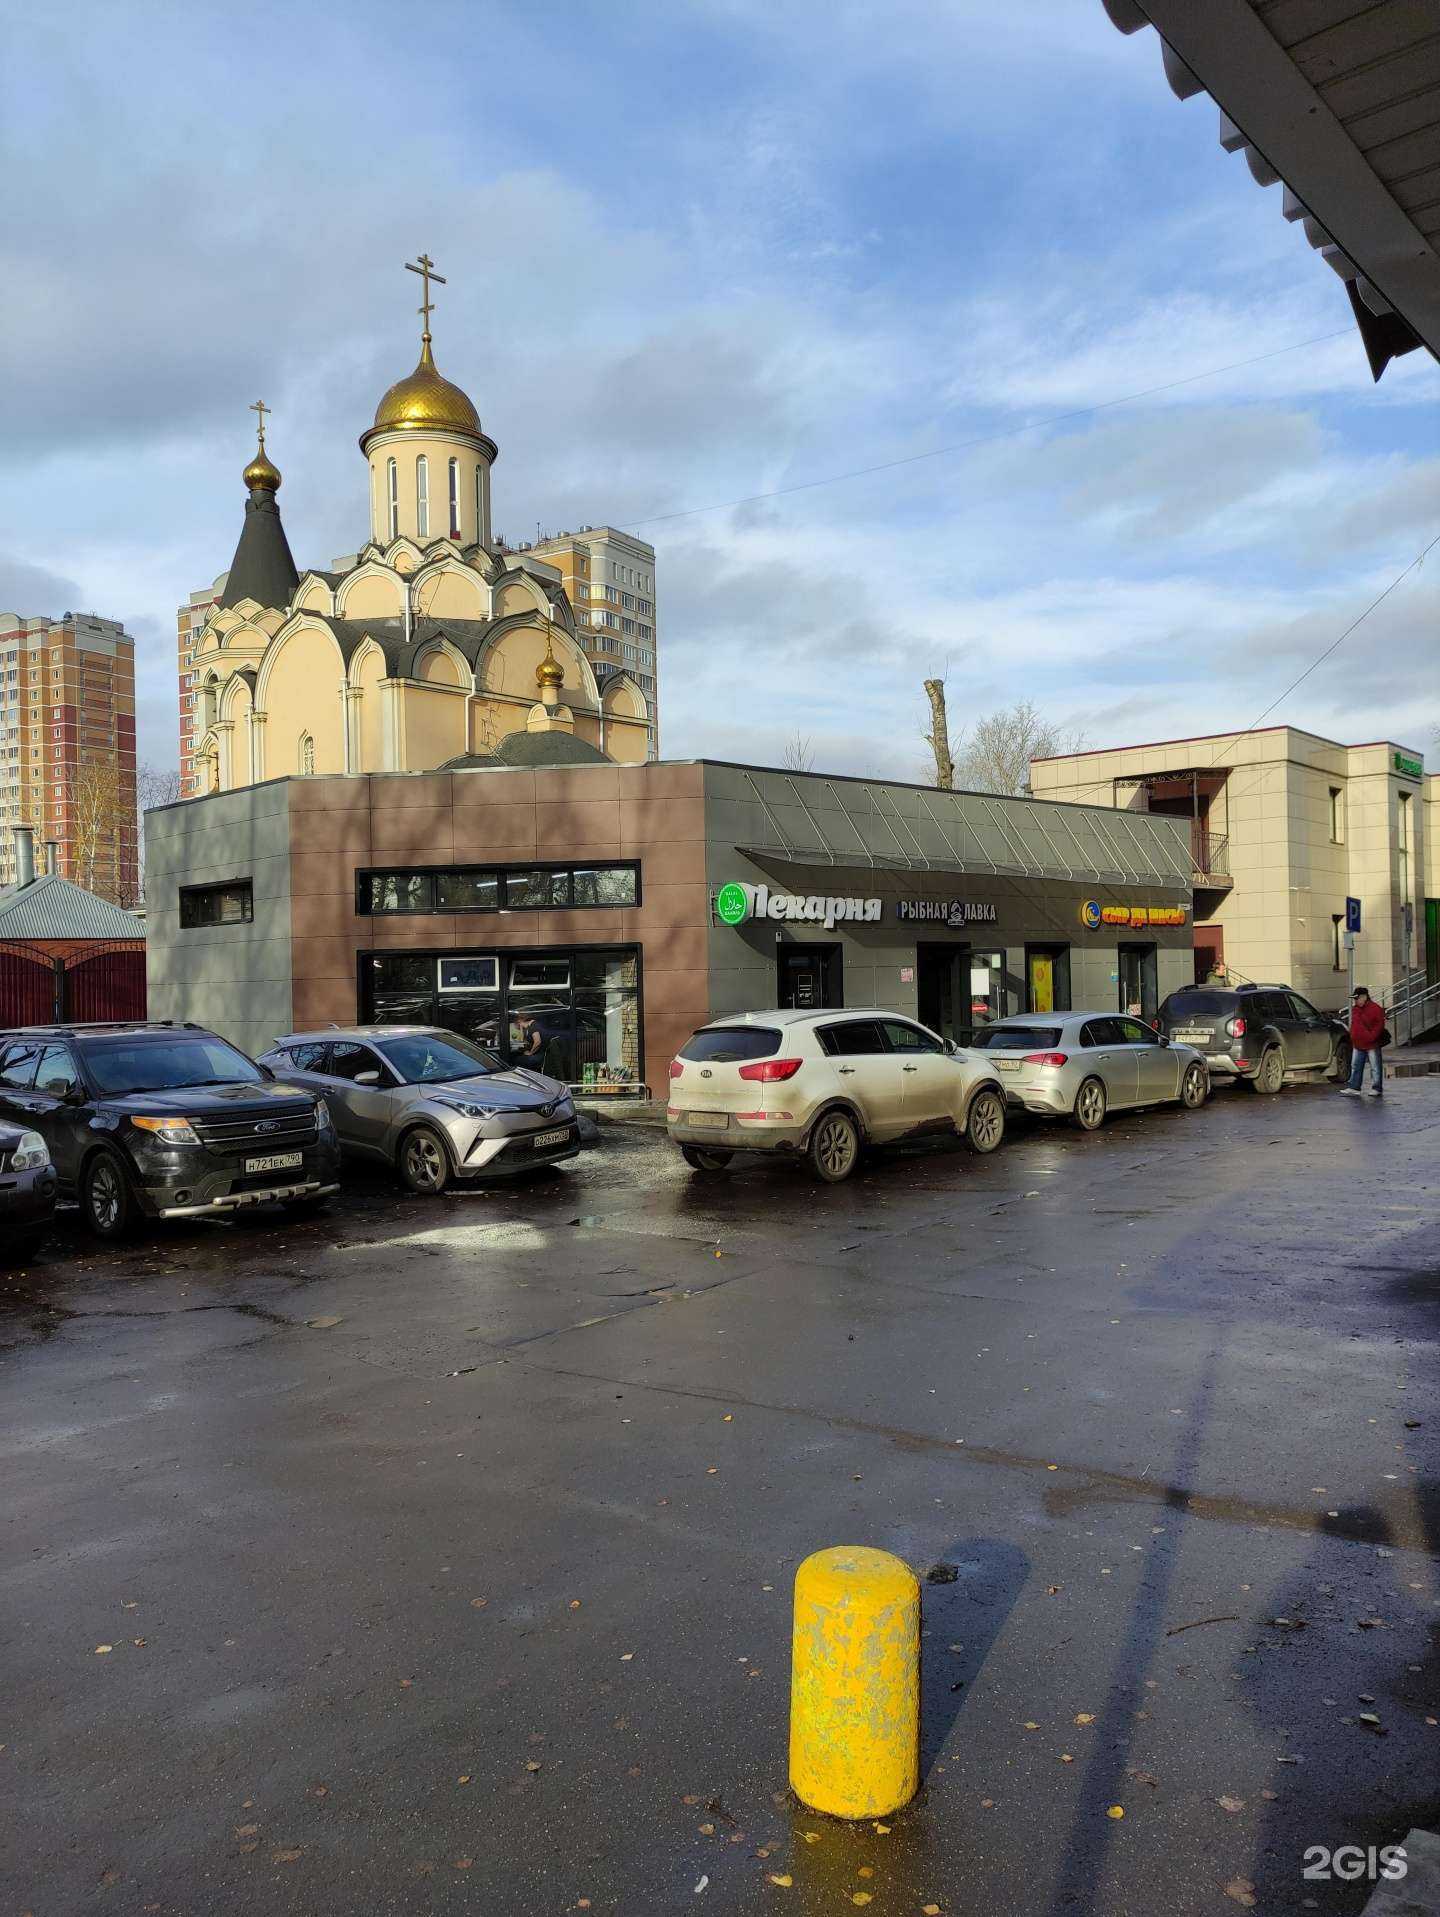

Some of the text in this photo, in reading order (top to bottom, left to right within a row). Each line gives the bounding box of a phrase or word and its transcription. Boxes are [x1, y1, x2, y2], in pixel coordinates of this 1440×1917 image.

[748, 884, 881, 928] Пекарня
[901, 901, 996, 920] РЫБНАЯ ЛАВКА
